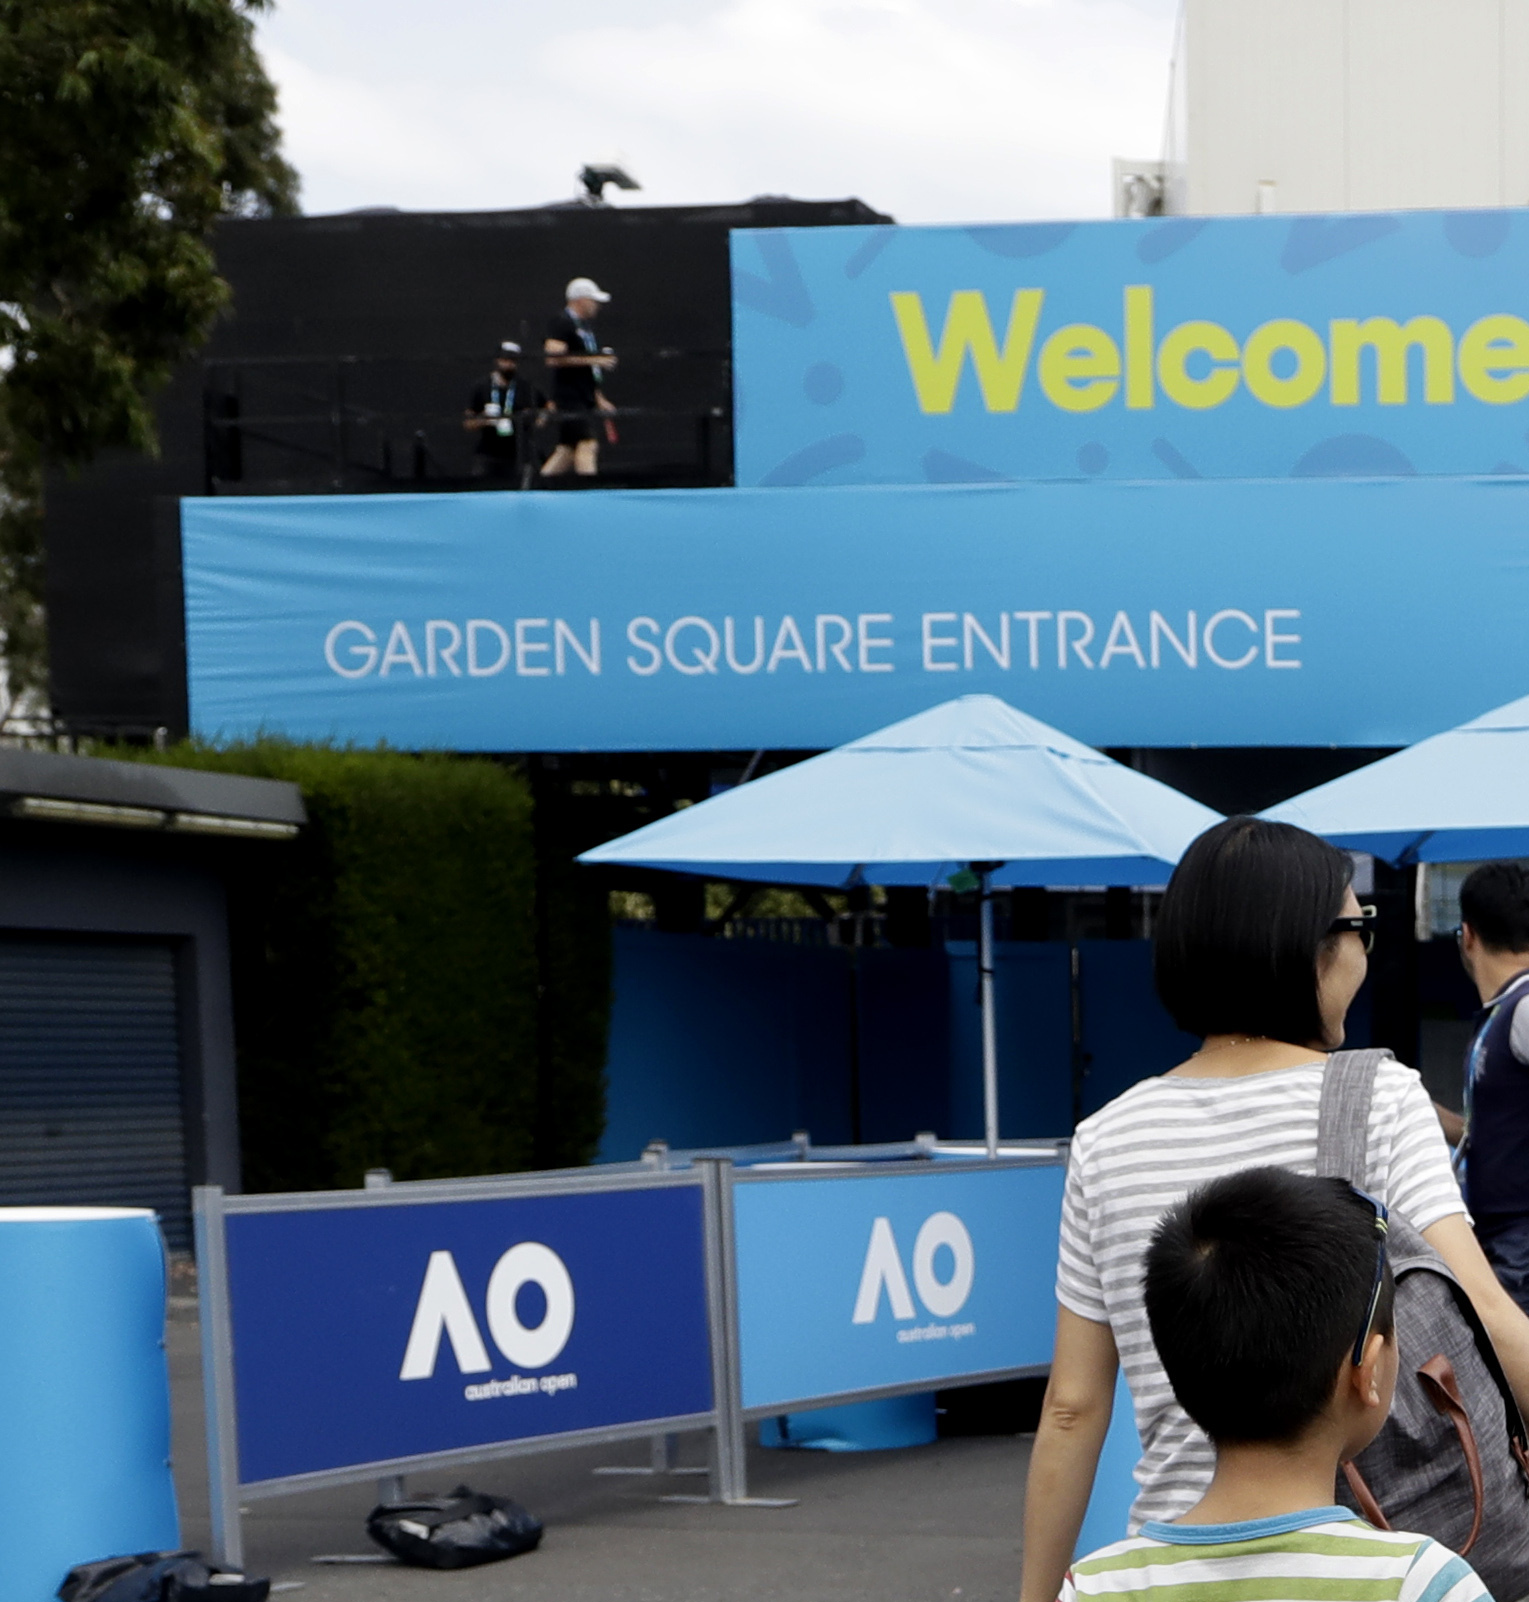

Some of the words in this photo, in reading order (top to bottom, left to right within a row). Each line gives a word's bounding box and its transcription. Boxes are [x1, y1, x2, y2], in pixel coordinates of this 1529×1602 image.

[323, 617, 601, 679] GARDEN
[625, 613, 895, 676] SQUARE
[921, 608, 1303, 671] ENTRANCE
[400, 1241, 576, 1381] AO
[852, 1210, 976, 1325] AO
[464, 1374, 539, 1401] australian
[540, 1372, 578, 1397] open
